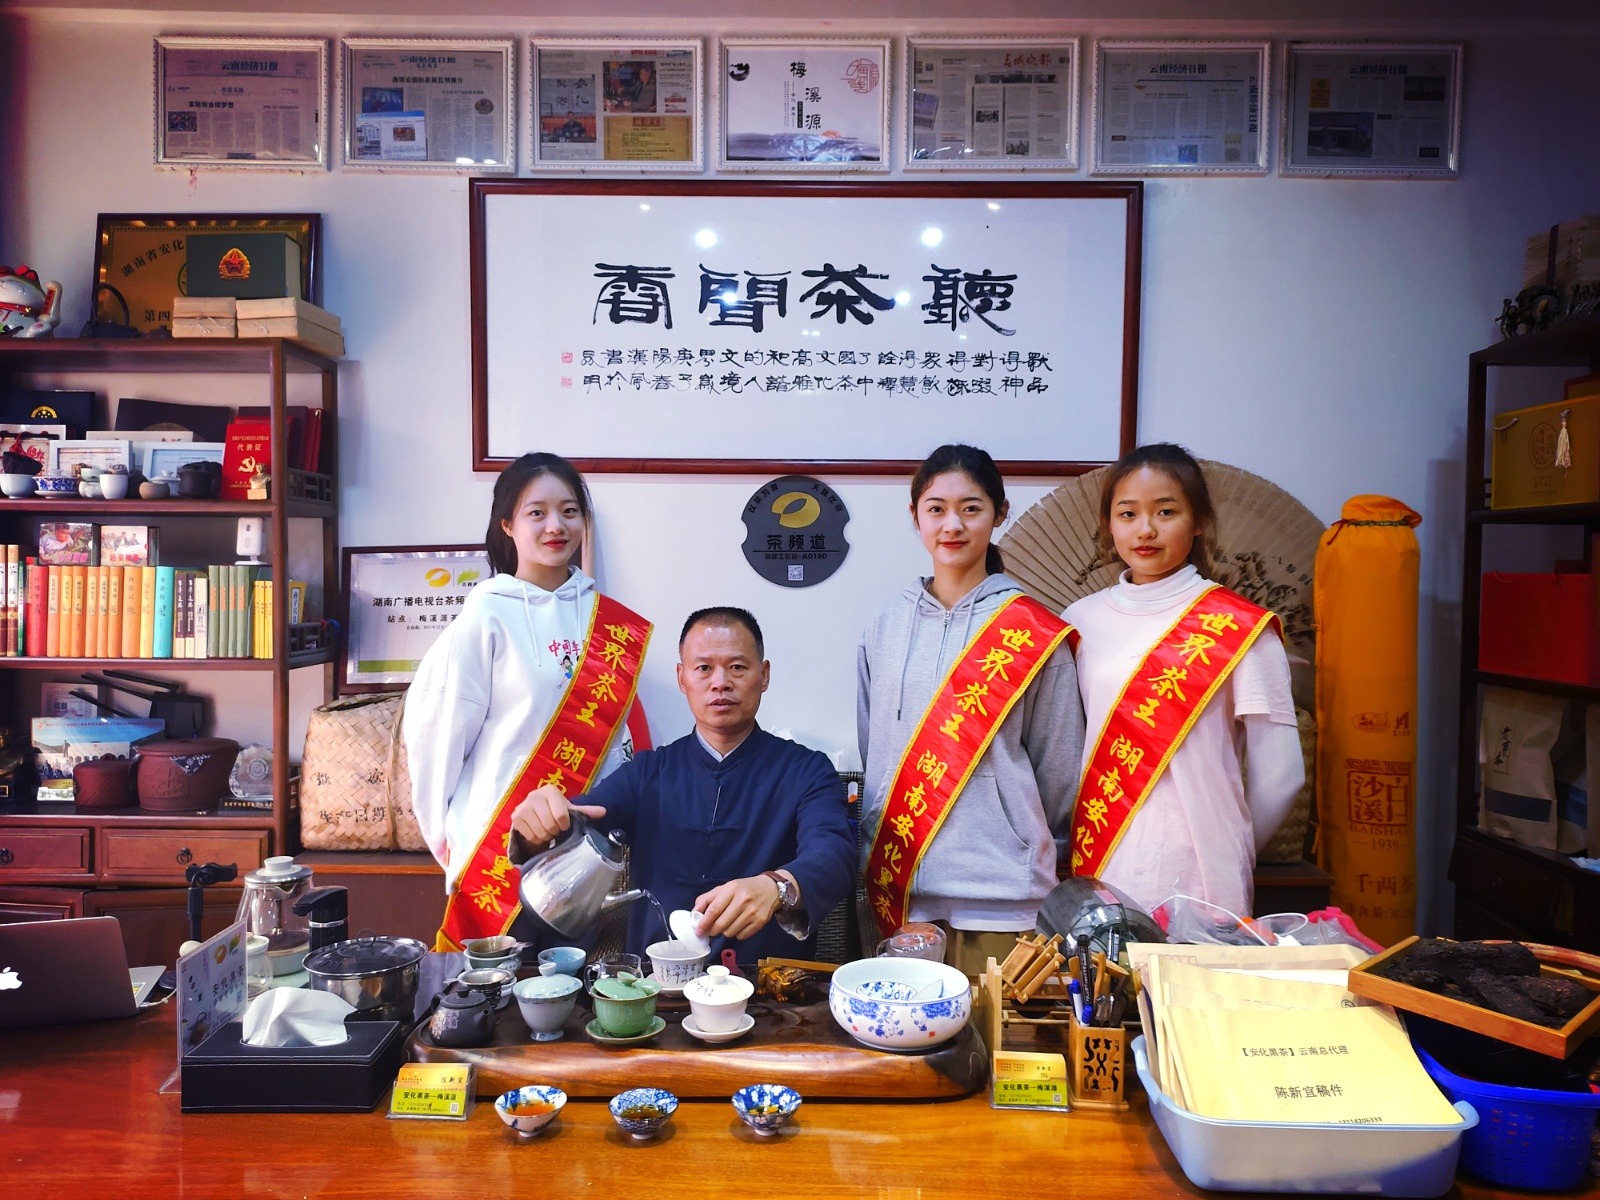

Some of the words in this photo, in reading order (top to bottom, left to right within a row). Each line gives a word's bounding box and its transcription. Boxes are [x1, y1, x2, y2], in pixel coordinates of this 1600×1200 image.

[221, 60, 279, 71] 云南经济日报
[1150, 63, 1208, 74] 云南经济日报
[1350, 63, 1408, 75] 云南经济日报
[121, 238, 185, 278] 湖南省安化
[144, 309, 171, 322] 第四
[766, 534, 826, 550] 茶频道
[372, 595, 467, 607] 湖南广播电视台茶频
[575, 622, 635, 728] 世界茶王
[1132, 611, 1239, 728] 世界茶王
[939, 626, 1035, 742] 世界茶王
[873, 749, 949, 926] 湖南安化黑茶
[1371, 838, 1399, 850] 1939
[1354, 873, 1413, 896] 千两茶
[1274, 1085, 1344, 1099] 陈新宜稿件
